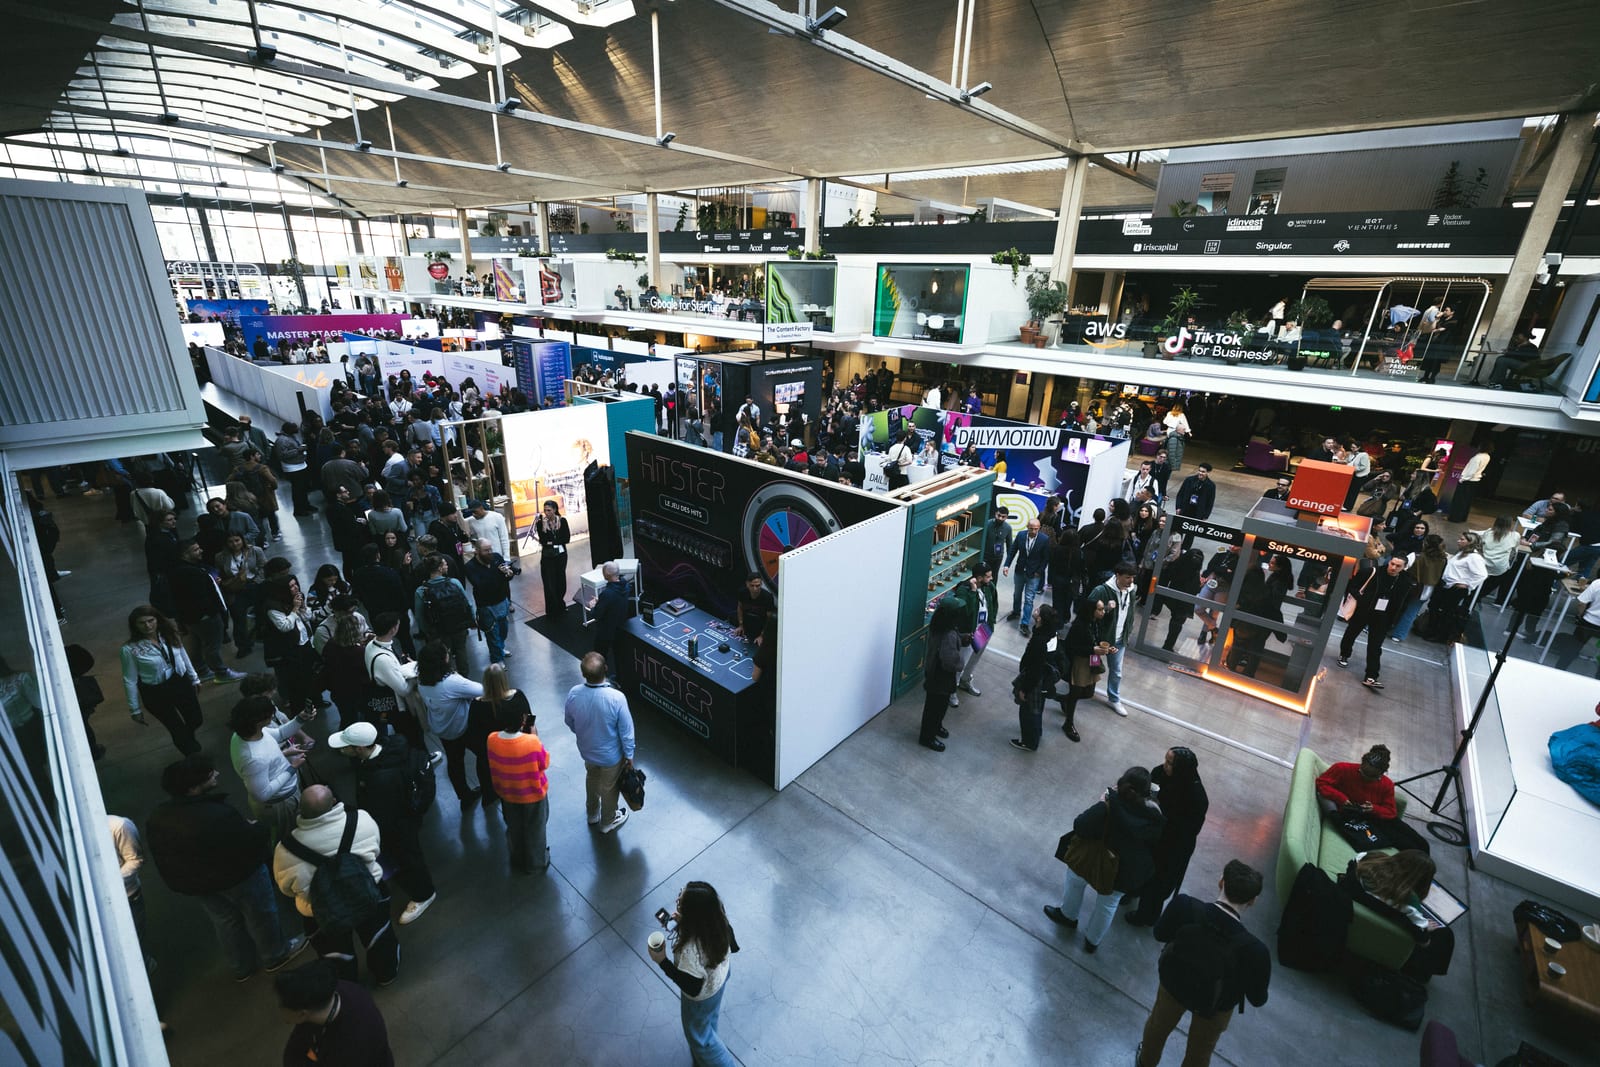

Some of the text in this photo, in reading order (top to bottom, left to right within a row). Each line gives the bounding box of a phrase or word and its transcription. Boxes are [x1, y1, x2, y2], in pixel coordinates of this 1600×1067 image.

[1227, 218, 1264, 226] idinvest
[1143, 243, 1179, 252] iriscapital
[650, 296, 725, 313] Google for Startups
[267, 331, 310, 339] MASTER
[311, 330, 343, 338] STAGE
[1085, 321, 1127, 339] aws
[1194, 332, 1242, 346] TikTok
[1191, 344, 1269, 361] for Business
[958, 429, 1058, 447] DAILYMOTION
[641, 451, 725, 505] HITSTER
[671, 501, 680, 510] JEU
[680, 505, 690, 514] DES
[690, 509, 702, 518] HITS
[1289, 497, 1335, 513] orange
[1182, 521, 1233, 540] Safe Zone
[1268, 541, 1328, 562] Safe Zone
[634, 648, 713, 720] HITSTER
